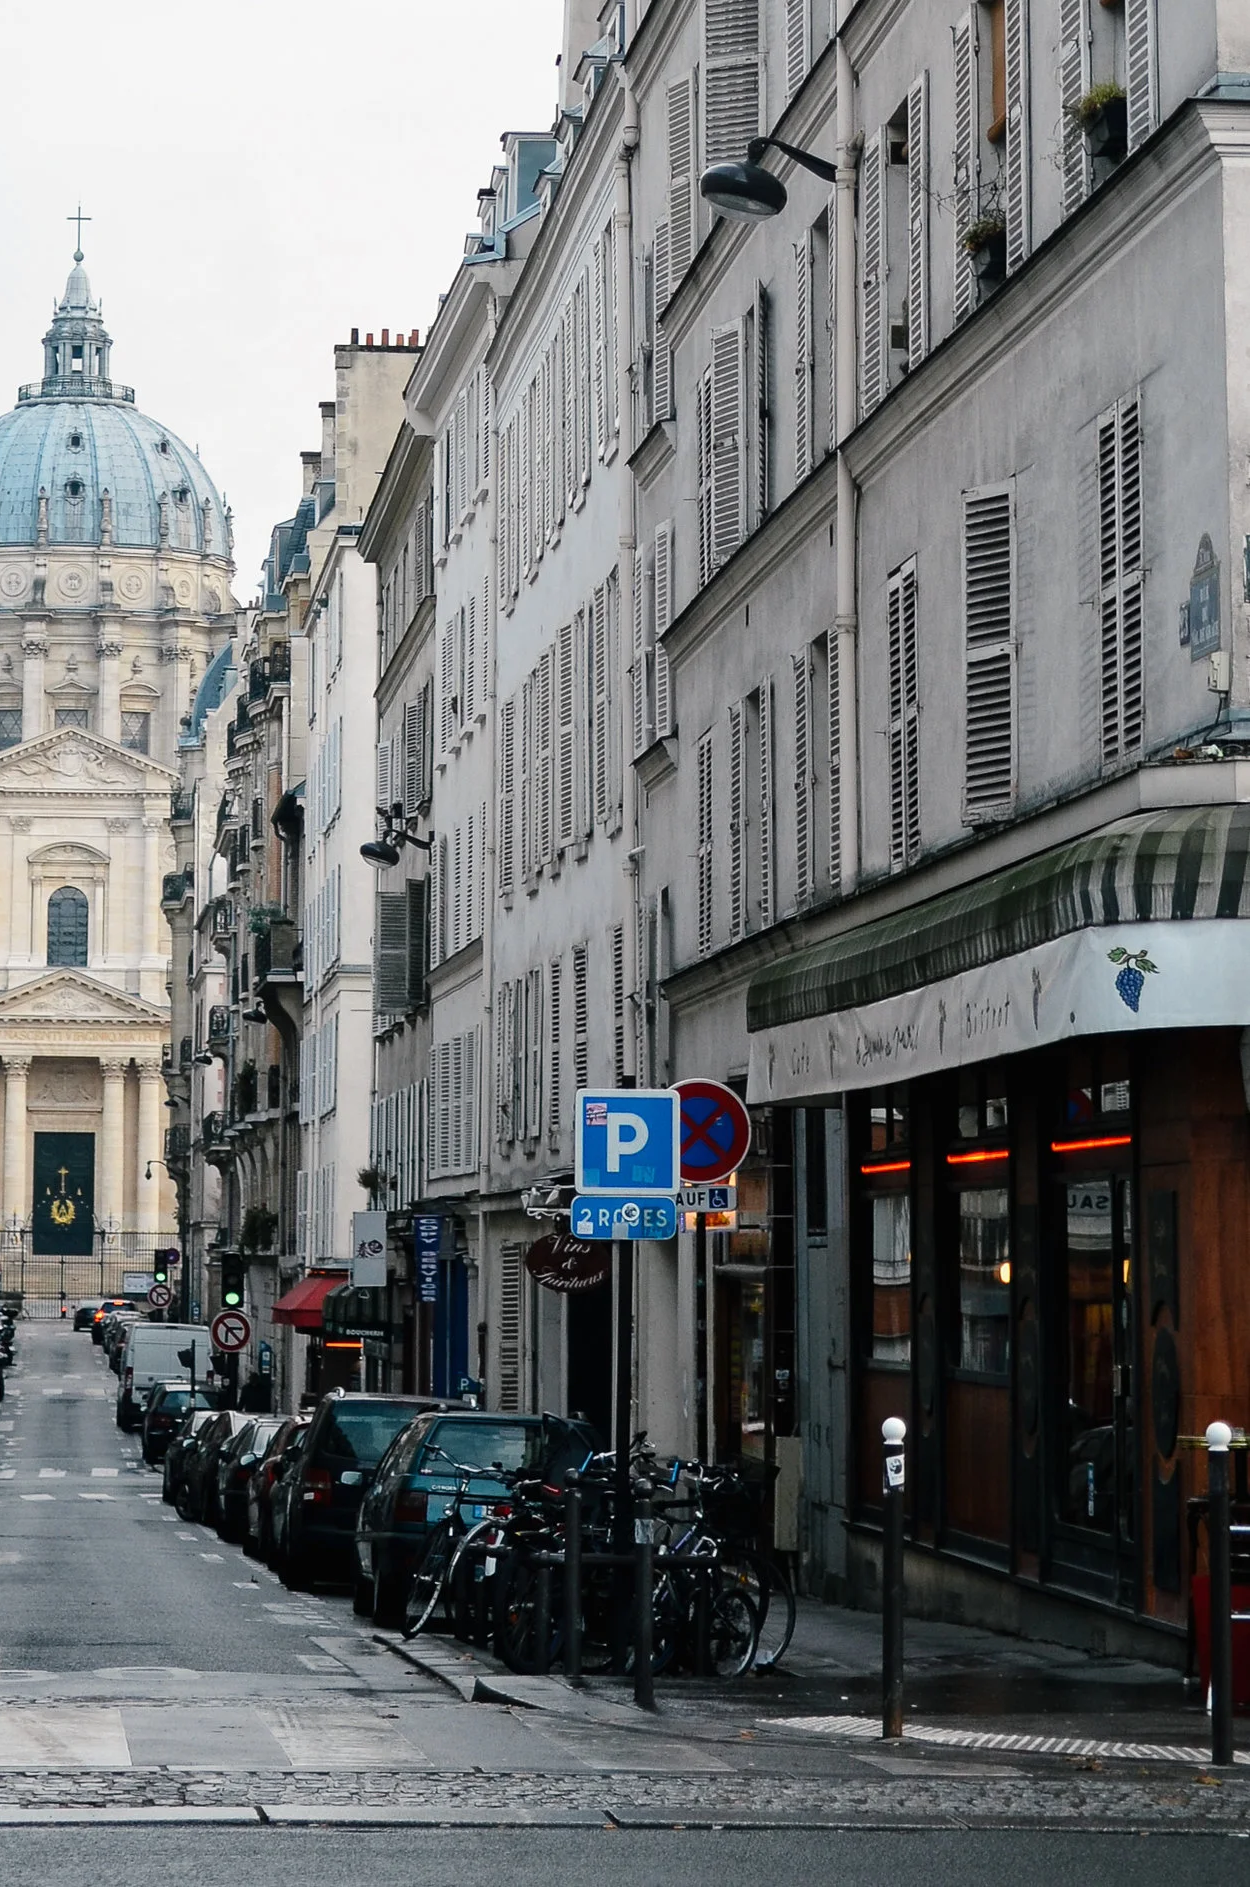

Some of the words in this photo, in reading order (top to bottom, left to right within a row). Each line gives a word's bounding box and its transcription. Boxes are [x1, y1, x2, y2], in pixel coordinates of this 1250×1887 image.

[966, 992, 1010, 1039] Bistrot
[606, 1112, 649, 1173] P
[419, 1218, 438, 1244] COPY
[548, 1234, 591, 1254] Vins
